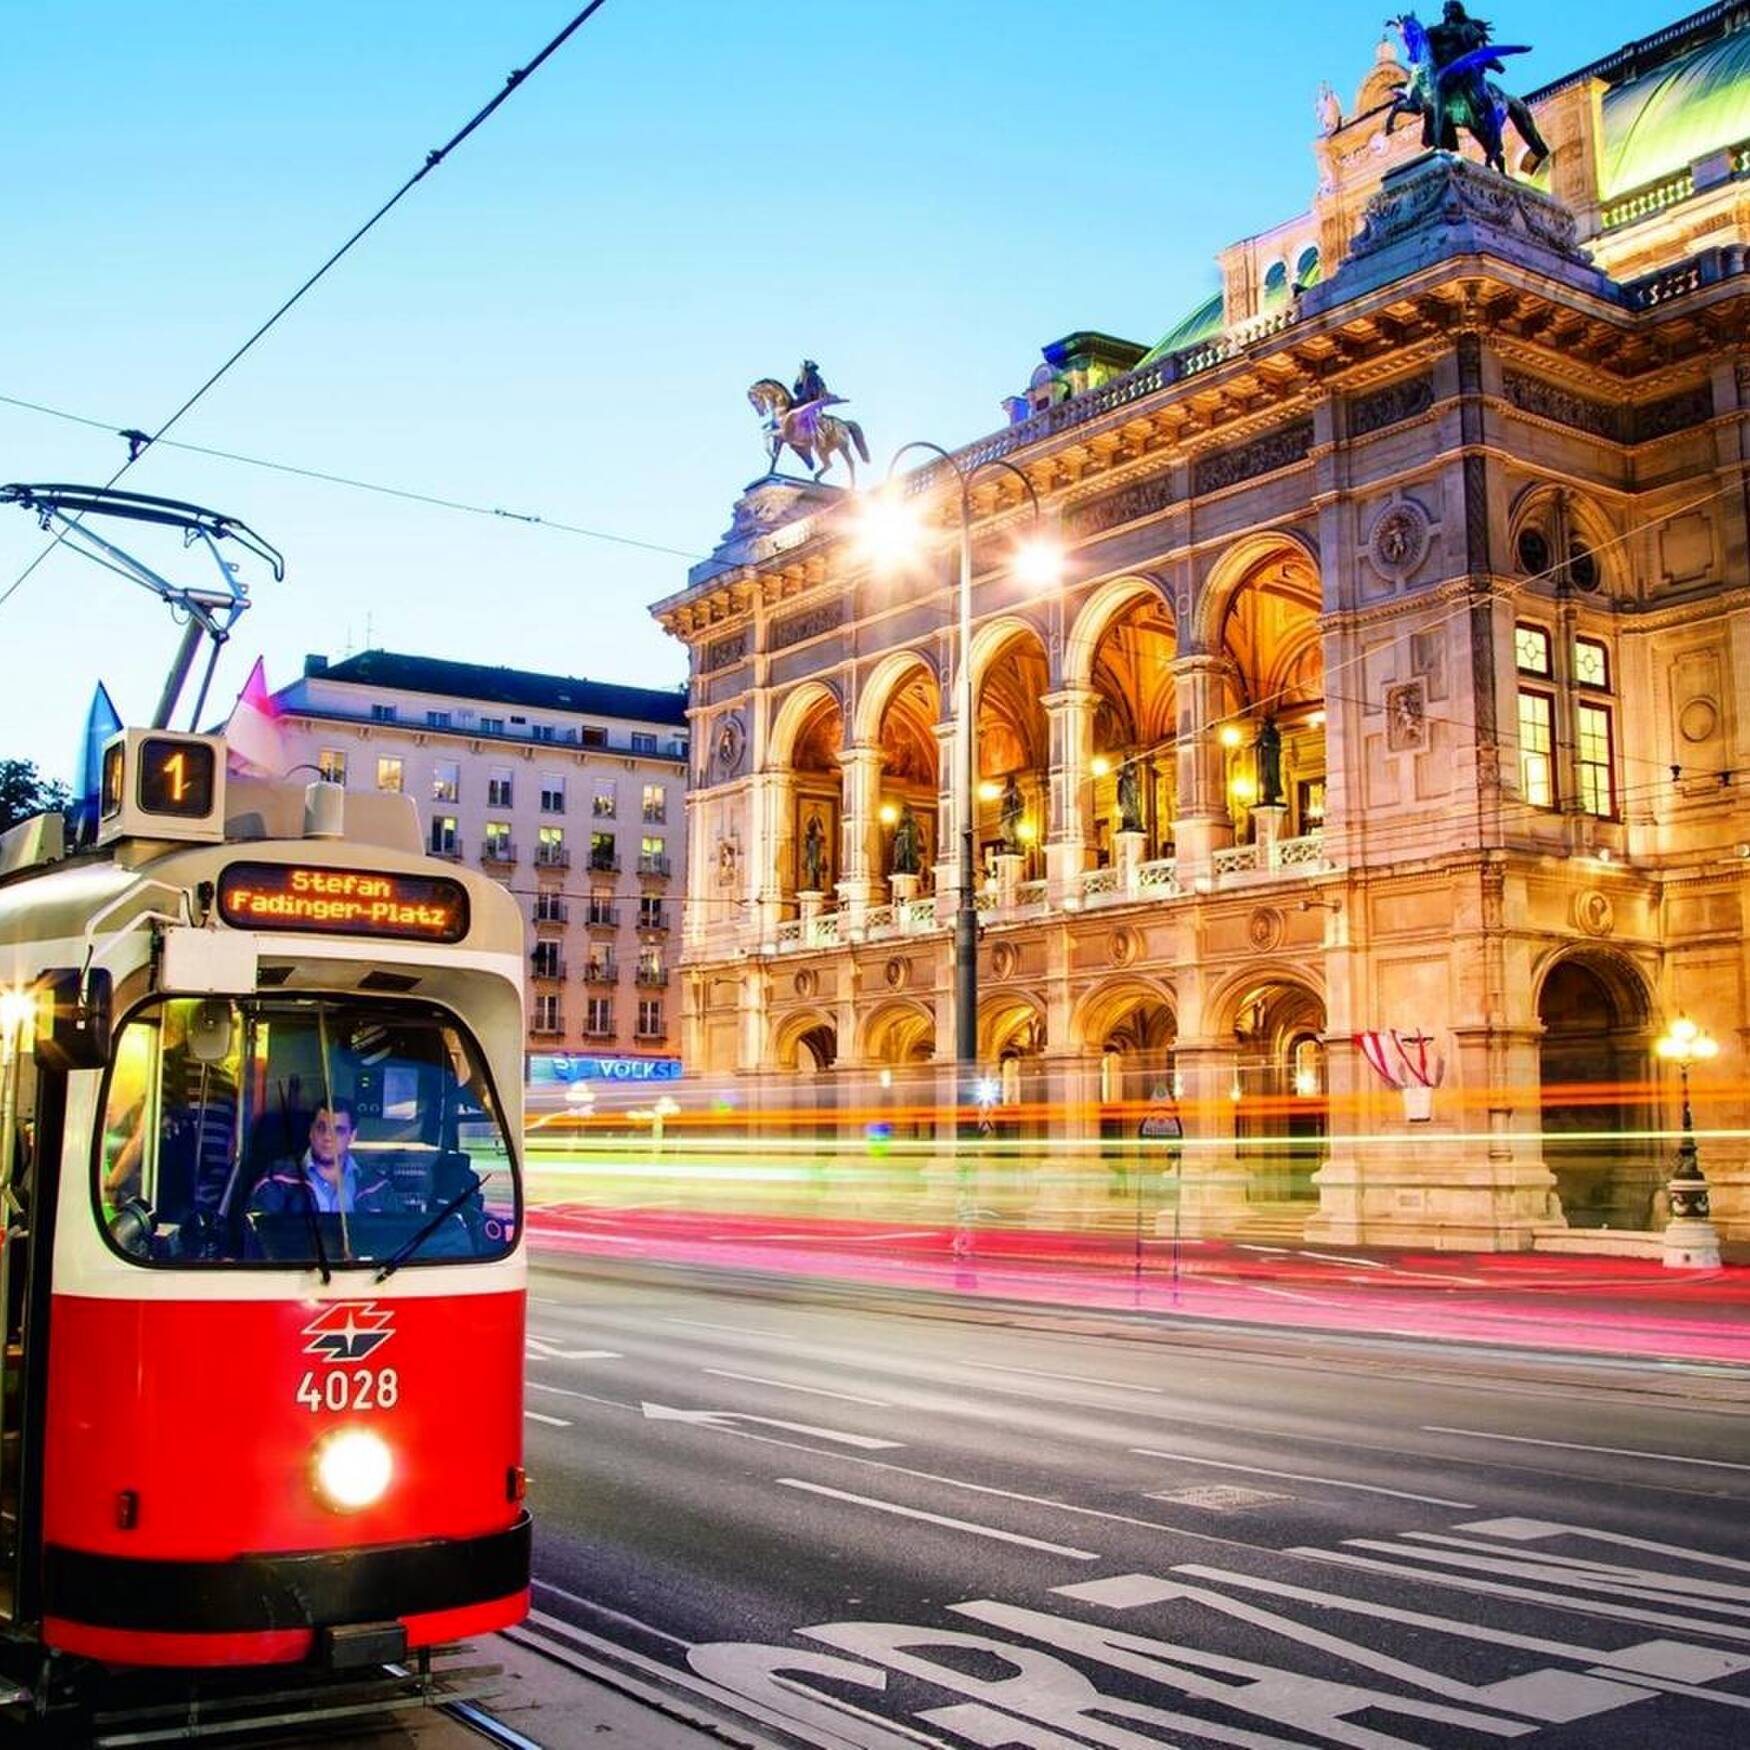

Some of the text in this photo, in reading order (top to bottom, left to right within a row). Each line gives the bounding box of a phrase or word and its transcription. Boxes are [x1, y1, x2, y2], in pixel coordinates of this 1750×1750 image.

[162, 752, 186, 801] 1
[291, 870, 391, 898] Stefan
[230, 890, 447, 926] Fadinger-Platz
[296, 1368, 398, 1413] 4028
